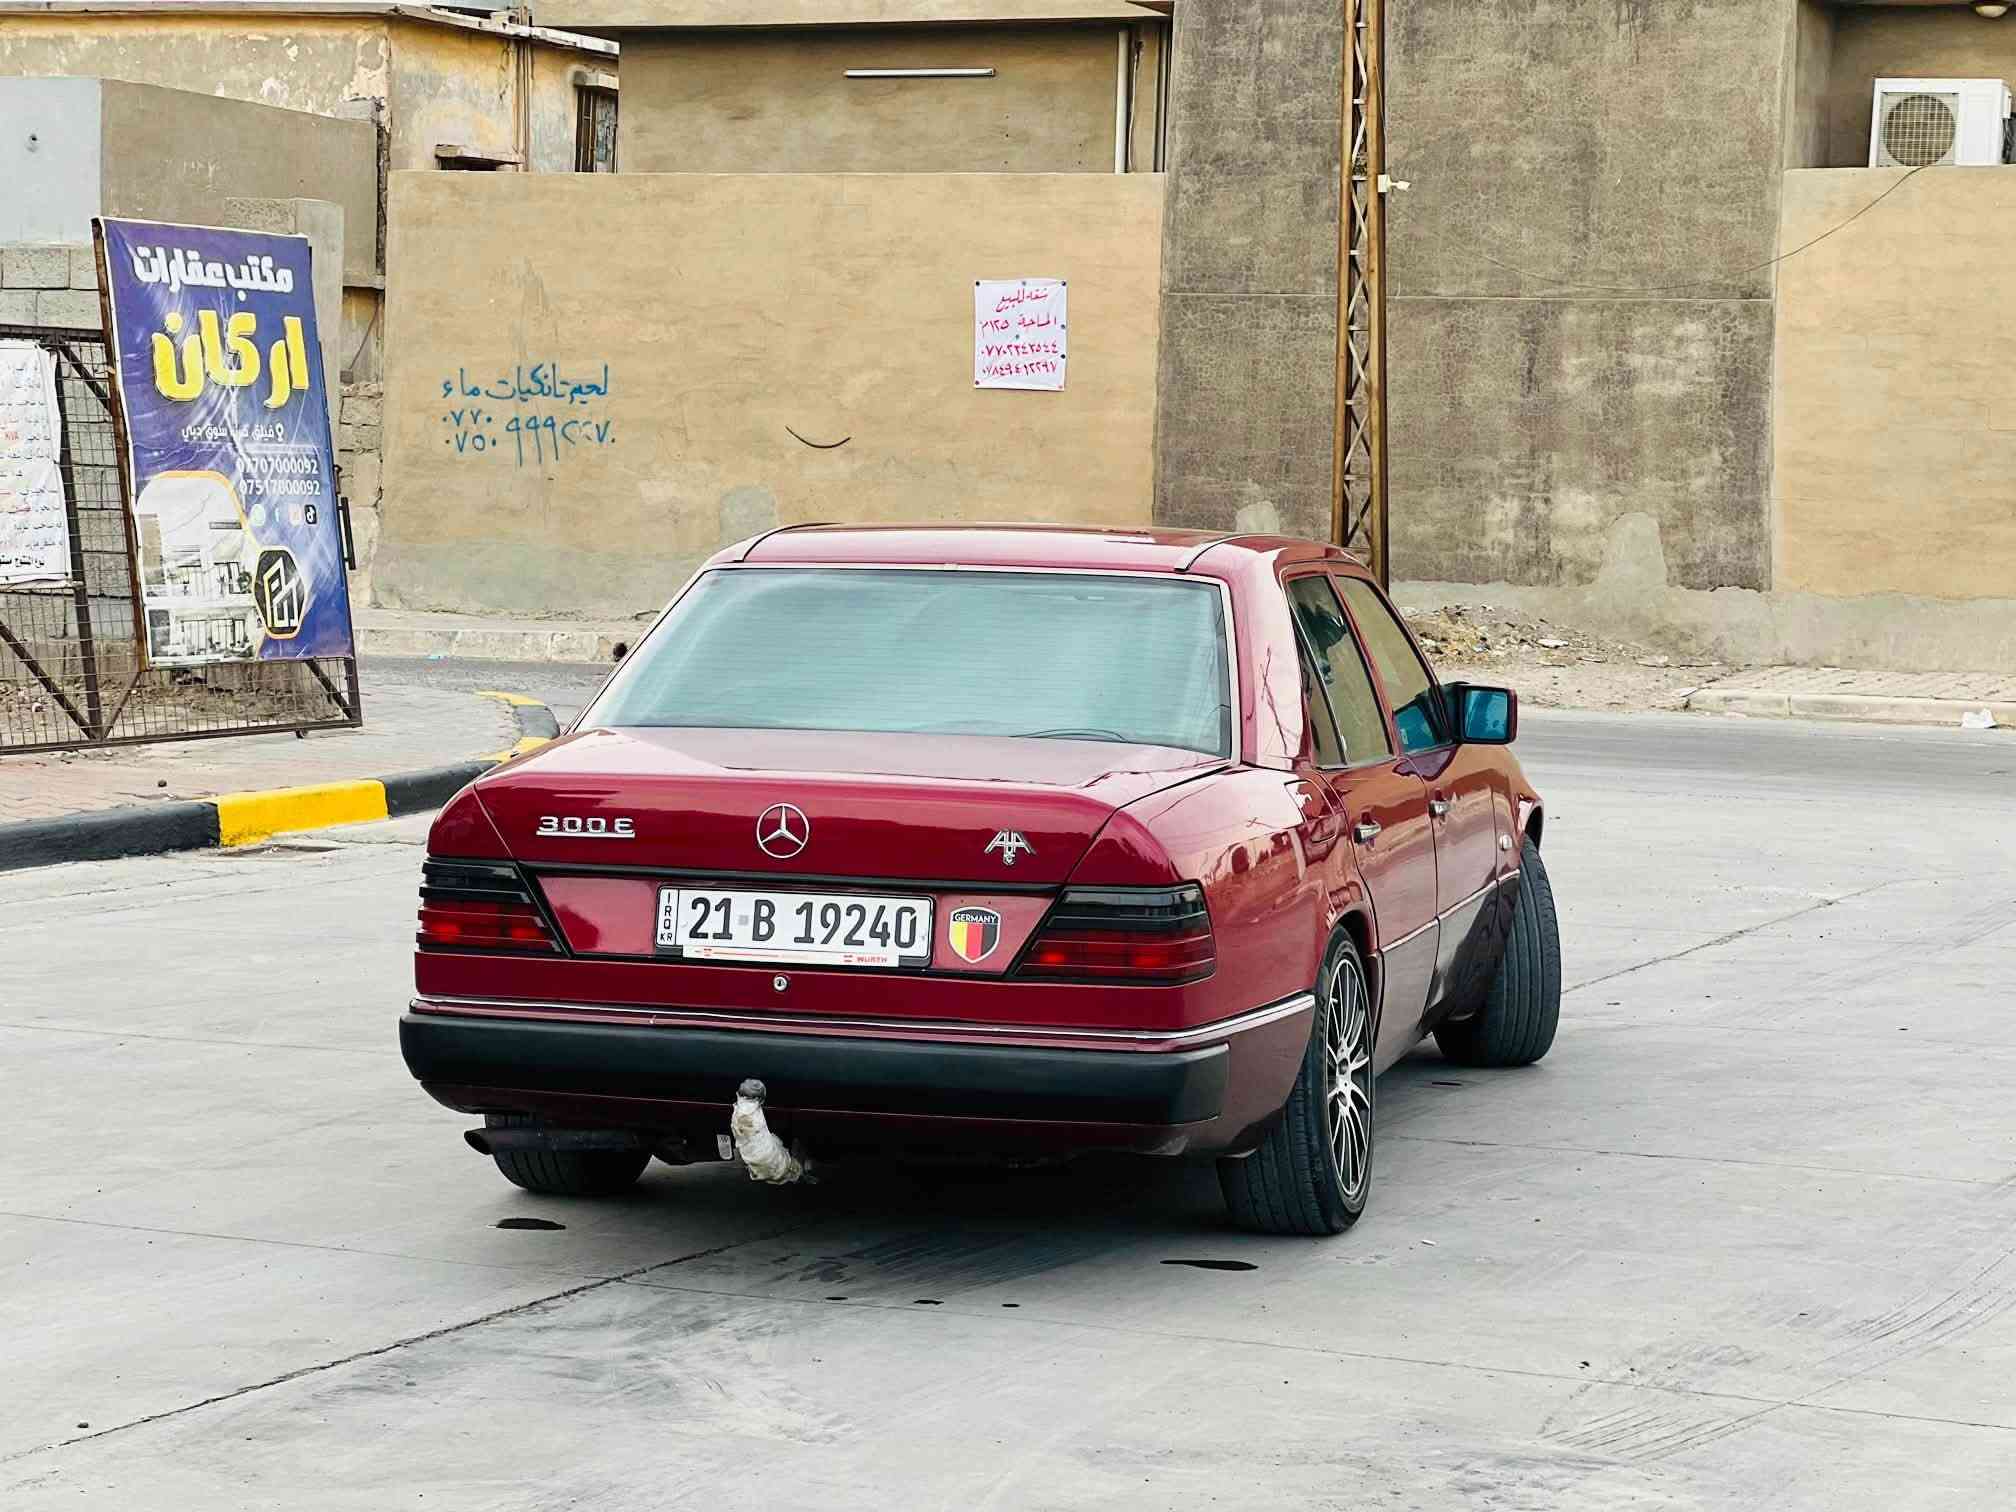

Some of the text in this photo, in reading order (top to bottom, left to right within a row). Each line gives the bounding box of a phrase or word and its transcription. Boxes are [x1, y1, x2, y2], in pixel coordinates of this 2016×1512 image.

[133, 246, 294, 301] مكتب عقارات
[443, 367, 481, 398] ماء
[689, 897, 917, 949] 21 B 19240
[954, 912, 997, 924] GERMANY
[660, 932, 673, 942] KR
